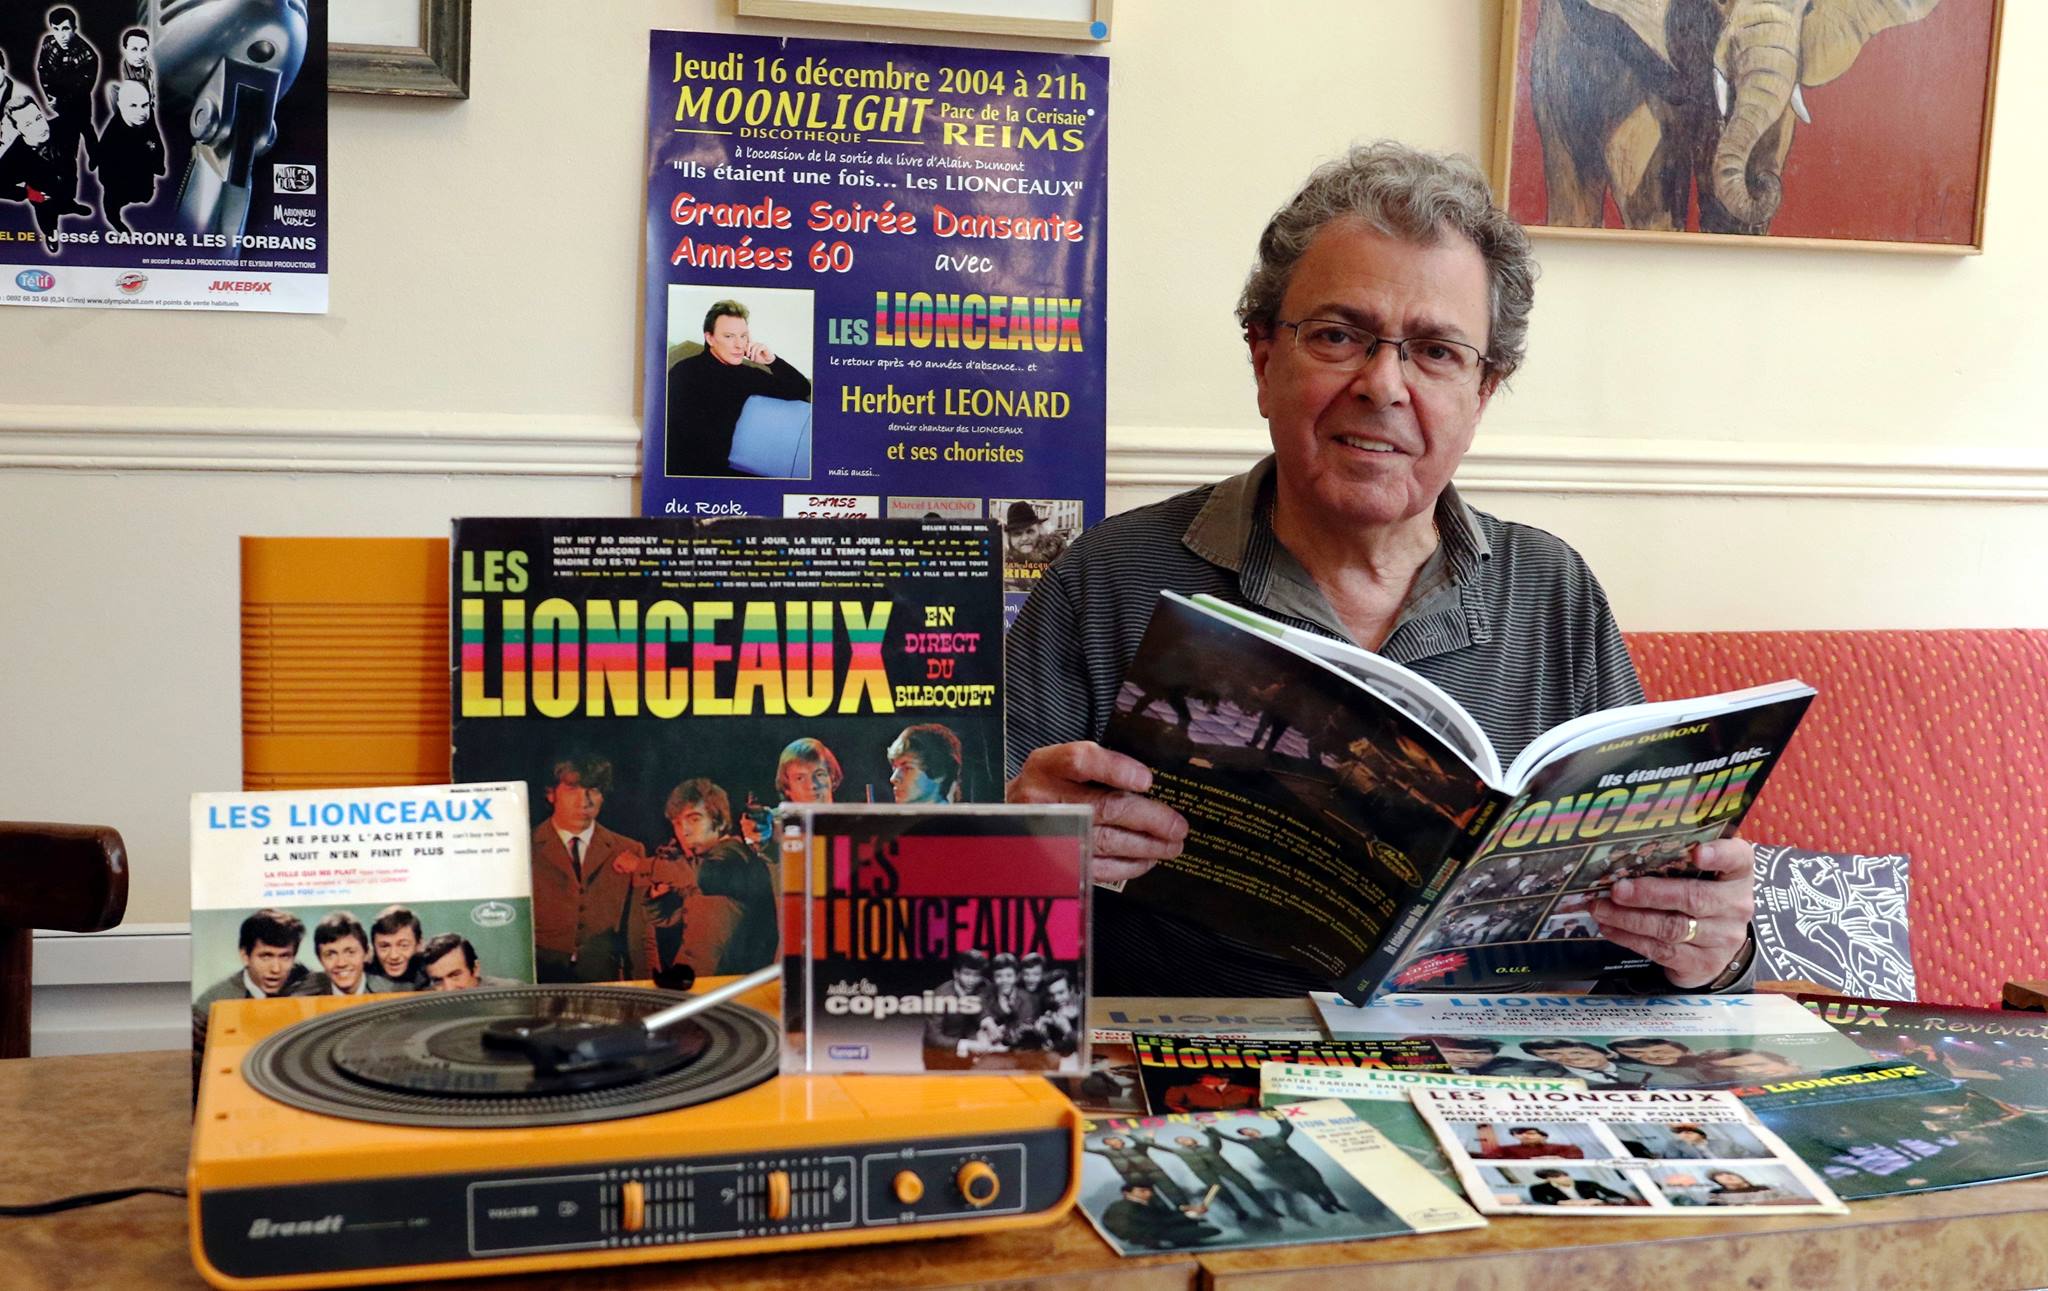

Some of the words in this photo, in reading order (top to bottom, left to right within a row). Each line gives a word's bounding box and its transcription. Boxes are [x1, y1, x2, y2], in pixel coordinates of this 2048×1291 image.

[673, 52, 743, 82] Jeudi
[753, 57, 787, 84] 16
[796, 57, 930, 91] décembre
[938, 67, 1005, 96] 2004
[1013, 70, 1028, 97] à
[1036, 73, 1087, 100] 21h
[675, 85, 934, 134] MOONLIGHT
[941, 103, 974, 119] Parc
[981, 104, 1000, 121] de
[1006, 105, 1019, 122] la
[1026, 107, 1086, 126] Cerisaie
[740, 127, 861, 143] DISCOTHEQUE
[943, 122, 1085, 152] REIMS
[735, 145, 743, 158] à
[746, 147, 805, 160] l'occasion
[807, 149, 822, 161] de
[824, 149, 836, 162] la
[839, 150, 873, 164] sortie
[876, 153, 893, 165] du
[896, 153, 923, 166] livre
[926, 155, 973, 169] d'Alain
[975, 159, 1025, 171] Dumont
[674, 161, 706, 180] "Ils
[713, 163, 785, 182] étaient
[792, 170, 831, 185] une
[838, 169, 897, 188] fois...
[906, 173, 938, 190] Les
[946, 175, 1084, 197] LIONCEAUX"
[670, 192, 793, 230] Grande
[807, 200, 917, 236] Soirée
[932, 204, 1084, 242] Dansante
[17, 232, 35, 241] DE
[49, 229, 100, 244] Jessé
[193, 234, 227, 247] LES
[232, 235, 317, 250] FORBANS
[670, 234, 793, 273] Années
[807, 240, 854, 273] 60
[935, 251, 993, 273] avec
[208, 281, 272, 292] JUKEBOX
[829, 318, 869, 346] LES
[875, 291, 1084, 352] LIONCEAUX
[830, 356, 840, 366] le
[842, 358, 875, 367] retour
[878, 358, 904, 371] après
[907, 360, 922, 369] 40
[925, 358, 963, 370] années
[1027, 362, 1038, 372] et
[841, 384, 935, 416] Herbert
[945, 388, 1071, 418] LEONARD
[888, 422, 917, 432] dernier
[918, 423, 954, 433] chanteur
[956, 424, 969, 433] des
[971, 425, 1024, 435] LIONCEAUX
[887, 441, 905, 461] et
[911, 445, 938, 461] ses
[943, 441, 1025, 463] choristes
[829, 467, 849, 477] mais
[664, 499, 692, 514] du
[694, 500, 749, 518] Rock,
[808, 496, 857, 509] DANSE
[891, 500, 926, 510] Marcel
[927, 500, 977, 511] LANCINO
[553, 536, 573, 545] HEY
[577, 536, 597, 545] HEY
[618, 536, 658, 545] DIDDLEY
[745, 537, 757, 545] LE
[794, 537, 806, 545] LA
[840, 537, 852, 545] LE
[856, 537, 881, 545] JOUR
[553, 547, 590, 556] QUATRE
[646, 547, 672, 556] DANS
[678, 547, 689, 555] LE
[693, 547, 718, 556] VENT
[788, 548, 816, 556] PASSE
[821, 548, 832, 556] LE
[836, 548, 867, 556] TEMPS
[870, 548, 895, 556] SANS
[462, 550, 529, 593] LES
[553, 558, 590, 567] NADINE
[924, 605, 956, 627] EN
[904, 632, 980, 654] DIRECT
[462, 598, 896, 719] LIONCEAUX
[926, 658, 955, 679] DU
[894, 685, 995, 708] BILBOQUET
[1638, 722, 1711, 747] DUMONT
[1598, 774, 1622, 788] Ils
[1625, 761, 1694, 786] étaient
[1695, 757, 1725, 773] une
[209, 804, 271, 830] LES
[289, 797, 494, 829] LIONCEAUX
[263, 836, 280, 846] JE
[285, 834, 304, 845] NE
[311, 833, 351, 844] PEUX
[358, 830, 445, 843] L'ACHETER
[264, 851, 280, 862] LA
[289, 850, 320, 862] NUIT
[329, 849, 359, 860] N'EN
[370, 848, 403, 860] FINIT
[413, 846, 445, 858] PLUS
[827, 834, 900, 898] LES
[827, 897, 1053, 960] LIONCEAUX
[825, 990, 982, 1020] copains
[1450, 997, 1752, 1007] LIONCEAUX
[1801, 1000, 1891, 1028] AUX
[1137, 1036, 1174, 1046] LES
[1285, 1067, 1343, 1079] LES
[1368, 1071, 1564, 1092] LIONCEAUX
[1762, 1064, 1927, 1094] LIONCEAUX
[1429, 1090, 1485, 1101] LES
[1508, 1091, 1722, 1103] LIONCEAUX
[248, 1214, 344, 1240] Brandt
